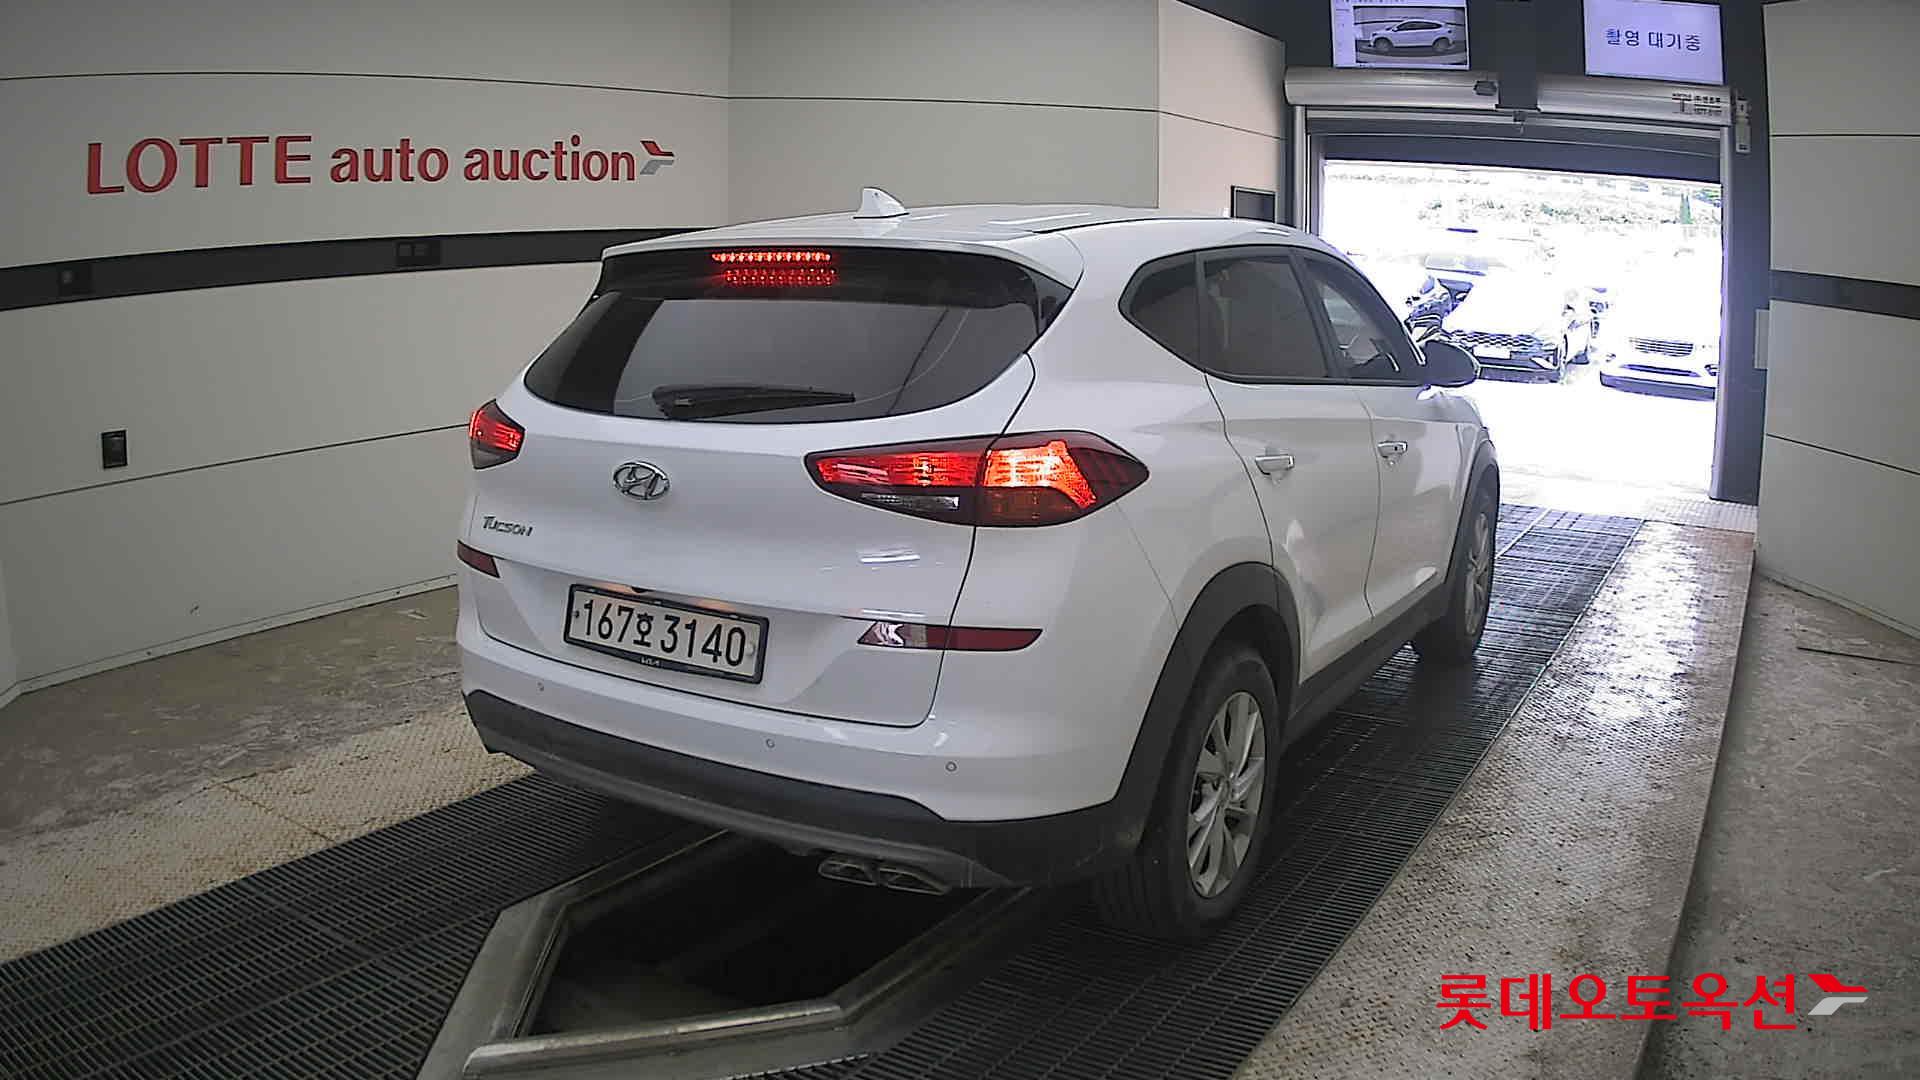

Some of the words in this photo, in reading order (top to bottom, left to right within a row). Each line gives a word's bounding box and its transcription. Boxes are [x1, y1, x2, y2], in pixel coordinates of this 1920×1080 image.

[1647, 31, 1701, 52] 대기중
[87, 135, 312, 194] LOTTE
[330, 138, 449, 183] auto
[463, 134, 636, 182] auction
